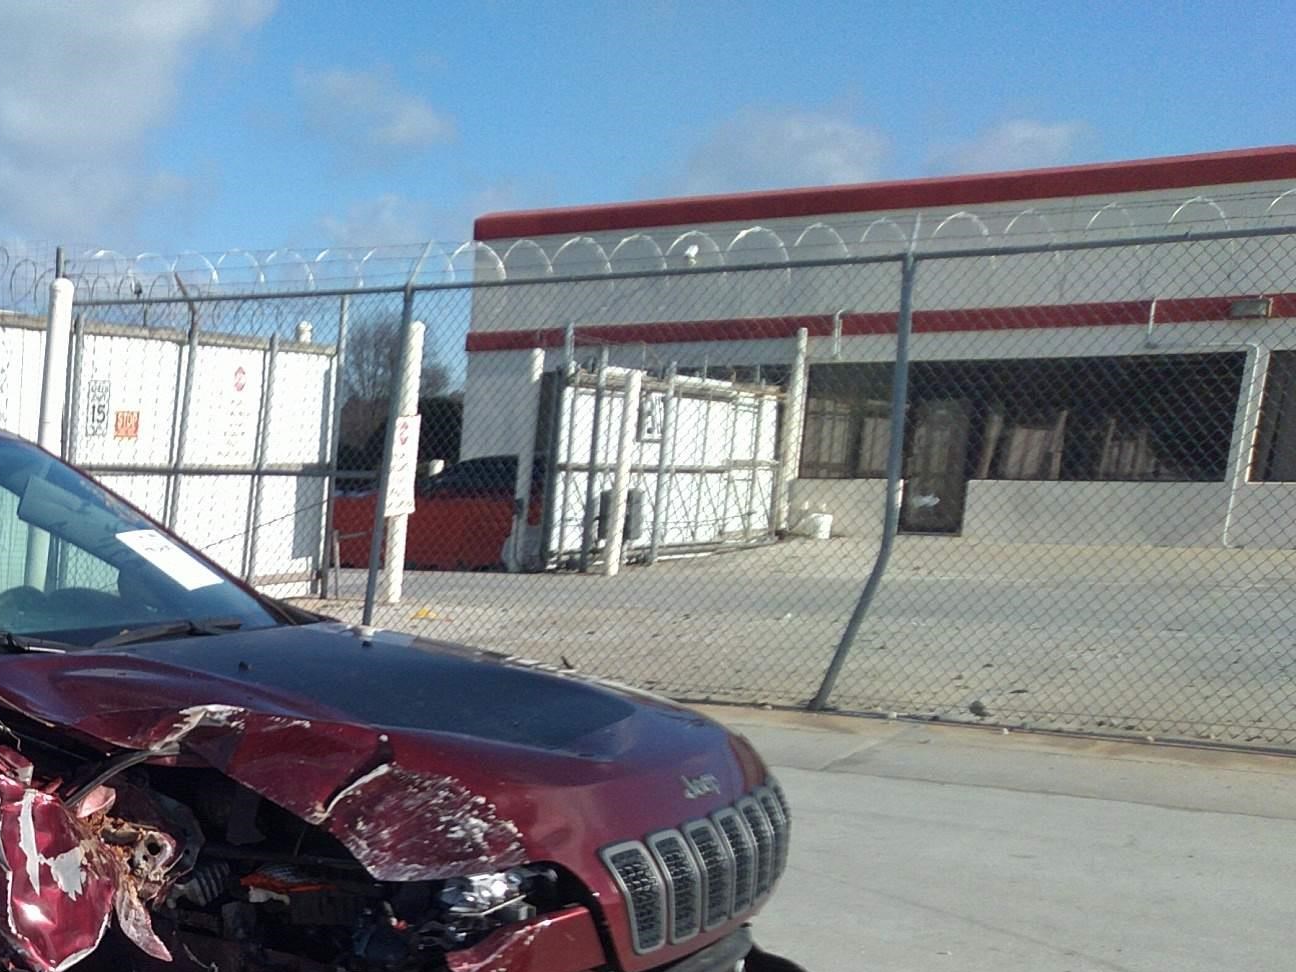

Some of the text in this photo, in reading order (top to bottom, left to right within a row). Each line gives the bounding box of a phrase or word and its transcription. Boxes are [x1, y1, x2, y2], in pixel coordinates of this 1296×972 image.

[92, 404, 106, 424] 15
[117, 413, 138, 428] STOP
[680, 774, 721, 800] Jeep
